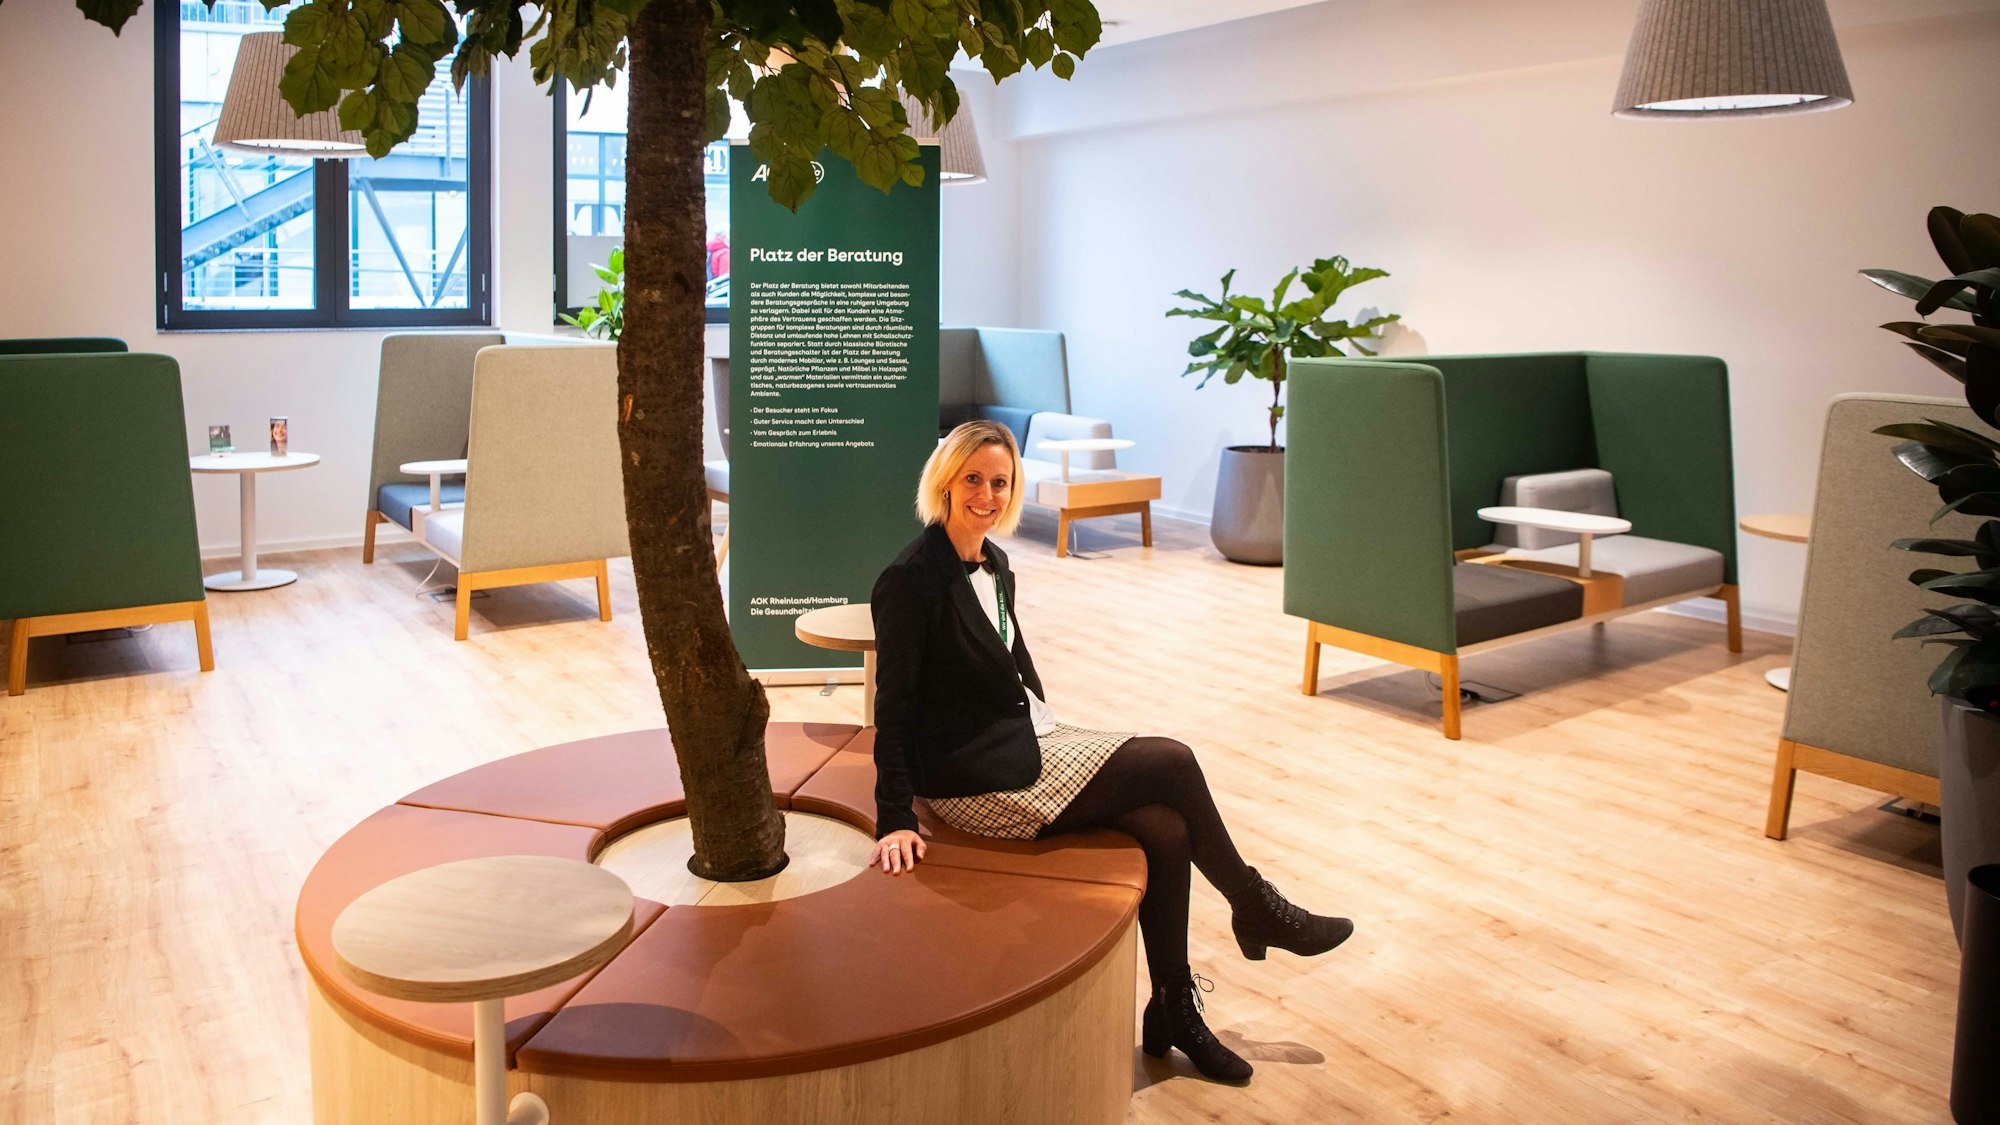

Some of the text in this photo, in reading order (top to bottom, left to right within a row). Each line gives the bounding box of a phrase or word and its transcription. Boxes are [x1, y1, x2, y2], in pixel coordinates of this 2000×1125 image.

[750, 248, 902, 266] Platz der Beratung
[791, 283, 820, 291] Beratung
[811, 291, 847, 299] Möglichkeit,
[848, 291, 876, 299] komplexe
[765, 299, 828, 307] Beratungsgespräche
[850, 299, 875, 307] ruhigere
[876, 299, 909, 307] Umgebung
[759, 307, 790, 315] verlagern.
[750, 316, 769, 324] phäre
[817, 316, 852, 324] geschaffen
[786, 324, 815, 332] komplexe
[816, 324, 851, 332] Beratungen
[777, 340, 806, 348] separiert.
[763, 349, 821, 357] Beratungsschalter
[872, 349, 900, 357] Beratung
[850, 357, 875, 365] Lounges
[750, 365, 777, 373] geprägt.
[879, 365, 907, 373] Holzoptik
[775, 382, 825, 390] naturbezogenes
[768, 429, 797, 437] Gespräch
[789, 440, 820, 449] Erfahrung
[845, 440, 874, 448] Angebots
[770, 596, 848, 605] Rheinland/Hamburg
